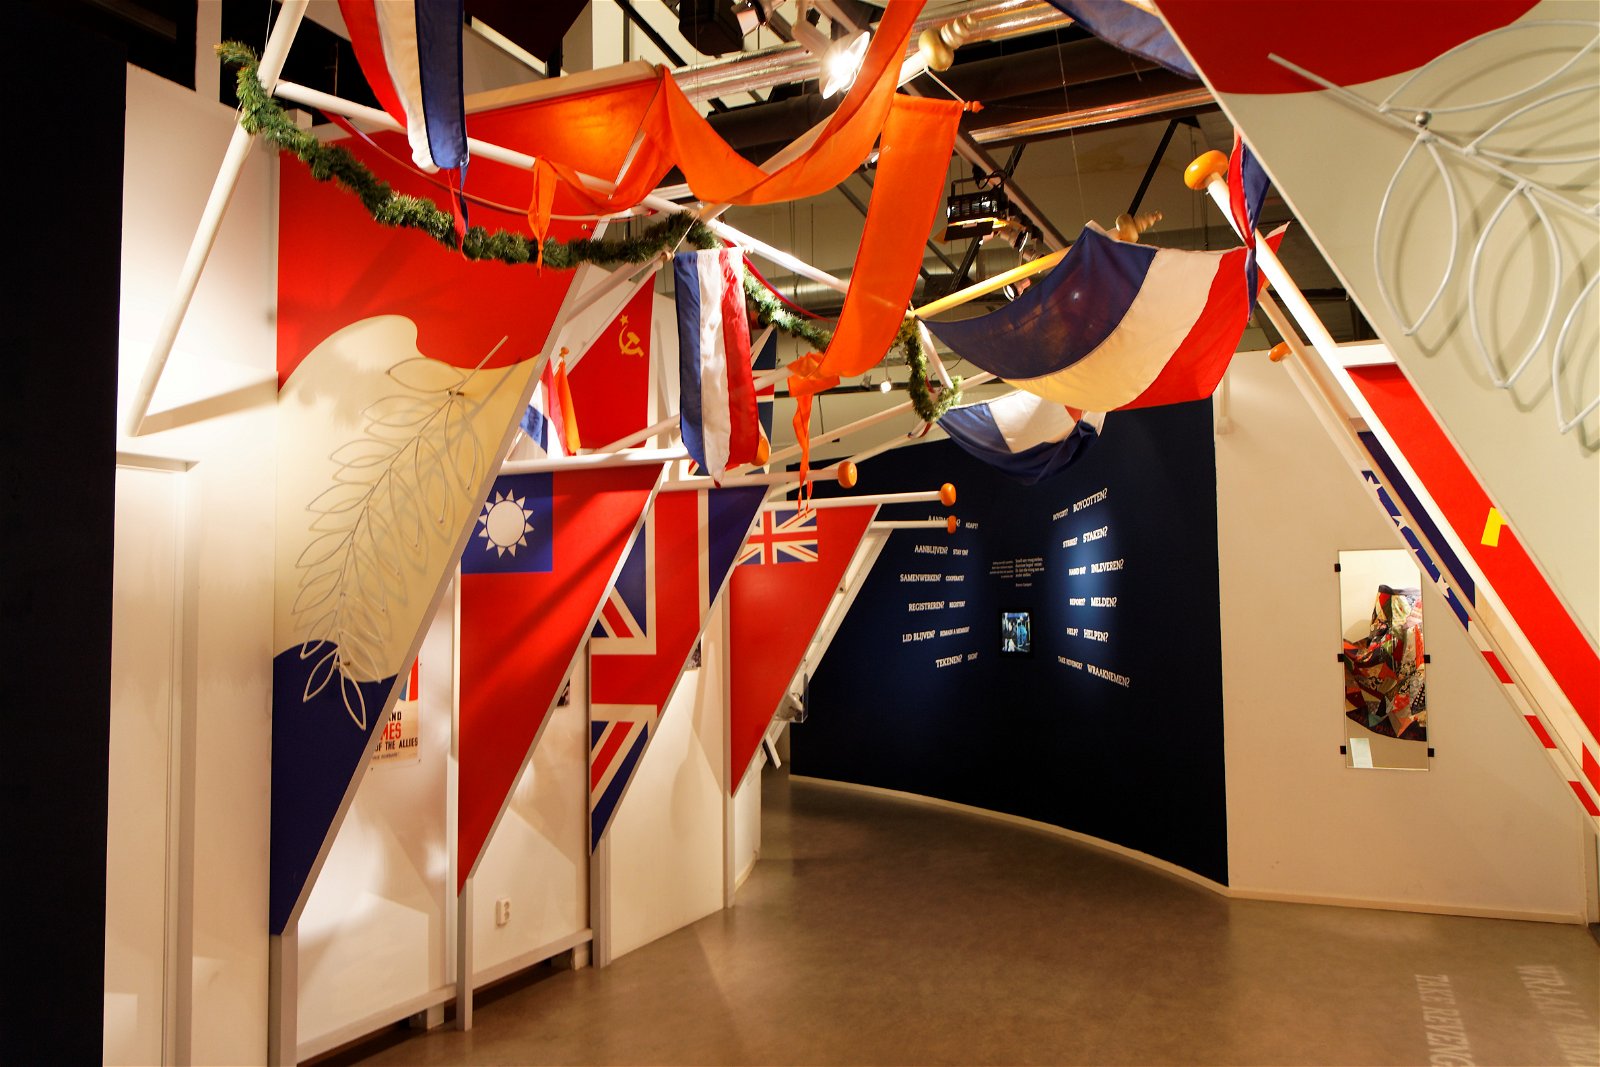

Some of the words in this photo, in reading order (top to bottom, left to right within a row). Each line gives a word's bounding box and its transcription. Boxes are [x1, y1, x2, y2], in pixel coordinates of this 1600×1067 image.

[1073, 488, 1107, 513] BOYCOTTEN?
[1083, 526, 1108, 543] STAKEN?
[915, 545, 948, 555] AANBLIJVEN?
[1091, 559, 1124, 573] INLEVEREN?
[900, 574, 941, 582] SAMENWERKEN?
[909, 601, 944, 612] REGISTREREN?
[1091, 597, 1117, 607] MELDEN?
[903, 634, 912, 642] LID
[913, 630, 935, 641] BLIJVEN?
[1084, 629, 1108, 642] HELPEN?
[936, 655, 962, 668] TEKENEN?
[1087, 664, 1130, 688] WRAAKNEMEN?
[385, 740, 396, 751] THE
[399, 737, 419, 748] ALLIES
[1414, 973, 1456, 1005] TAKE
